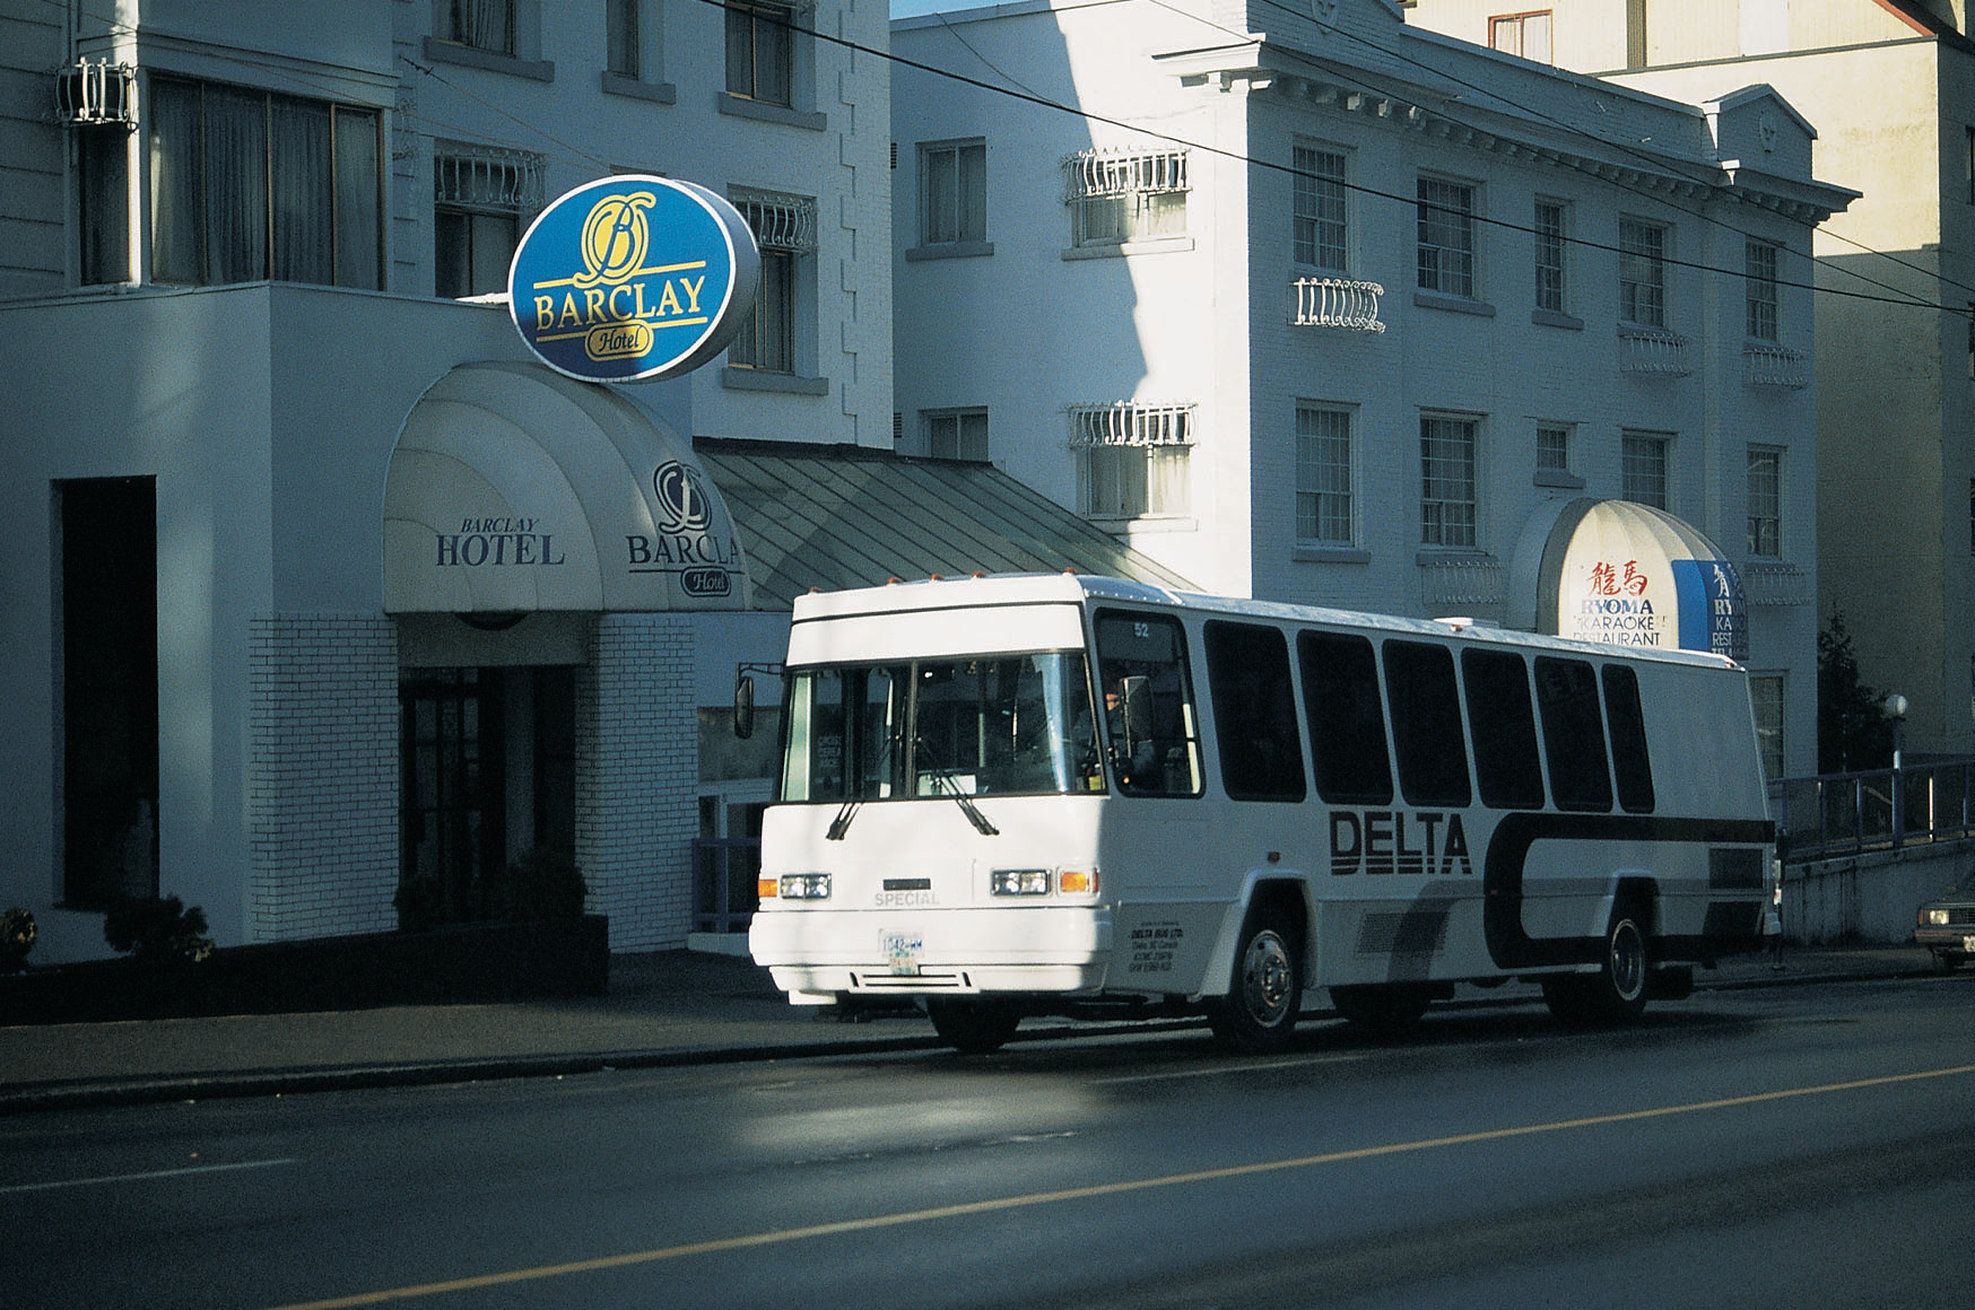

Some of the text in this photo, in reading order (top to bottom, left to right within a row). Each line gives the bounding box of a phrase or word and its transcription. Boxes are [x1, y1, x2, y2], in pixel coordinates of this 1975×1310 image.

[534, 276, 704, 330] BARCLAY
[598, 326, 640, 353] Hotel
[461, 517, 539, 533] BARCLAY
[436, 534, 566, 567] HOTEL
[1586, 559, 1649, 596] 龍馬
[1581, 598, 1654, 614] RYOMA
[1135, 622, 1149, 637] 52
[1330, 811, 1473, 875] DELTA
[875, 892, 940, 906] SPECIAL
